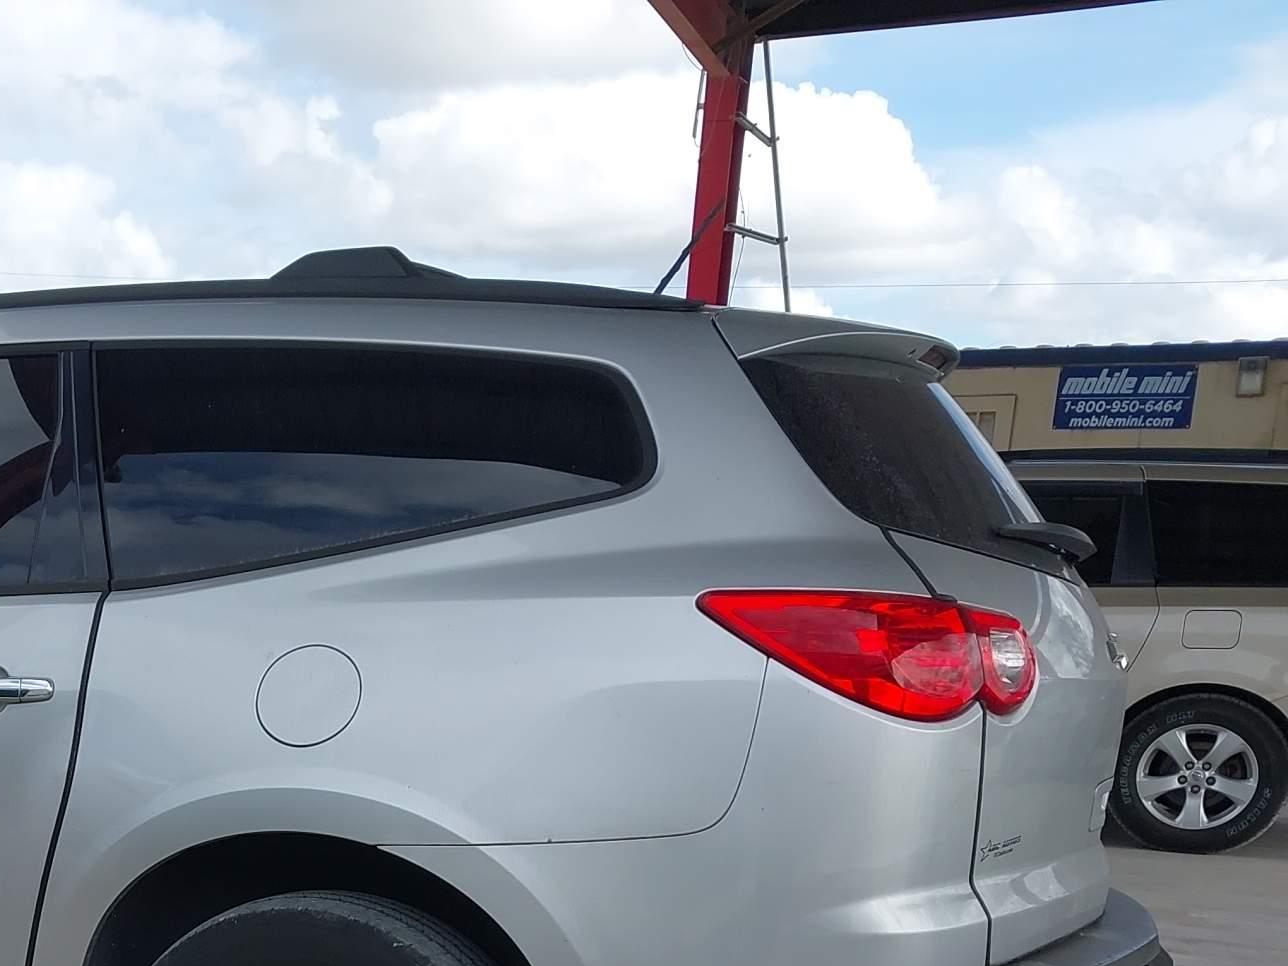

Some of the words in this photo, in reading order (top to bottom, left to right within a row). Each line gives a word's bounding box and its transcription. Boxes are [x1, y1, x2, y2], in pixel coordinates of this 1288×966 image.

[1061, 368, 1138, 395] mobile
[1137, 371, 1193, 394] mini
[1064, 400, 1184, 413] 1-800-950-6464
[1068, 415, 1175, 428] mobilemini.com
